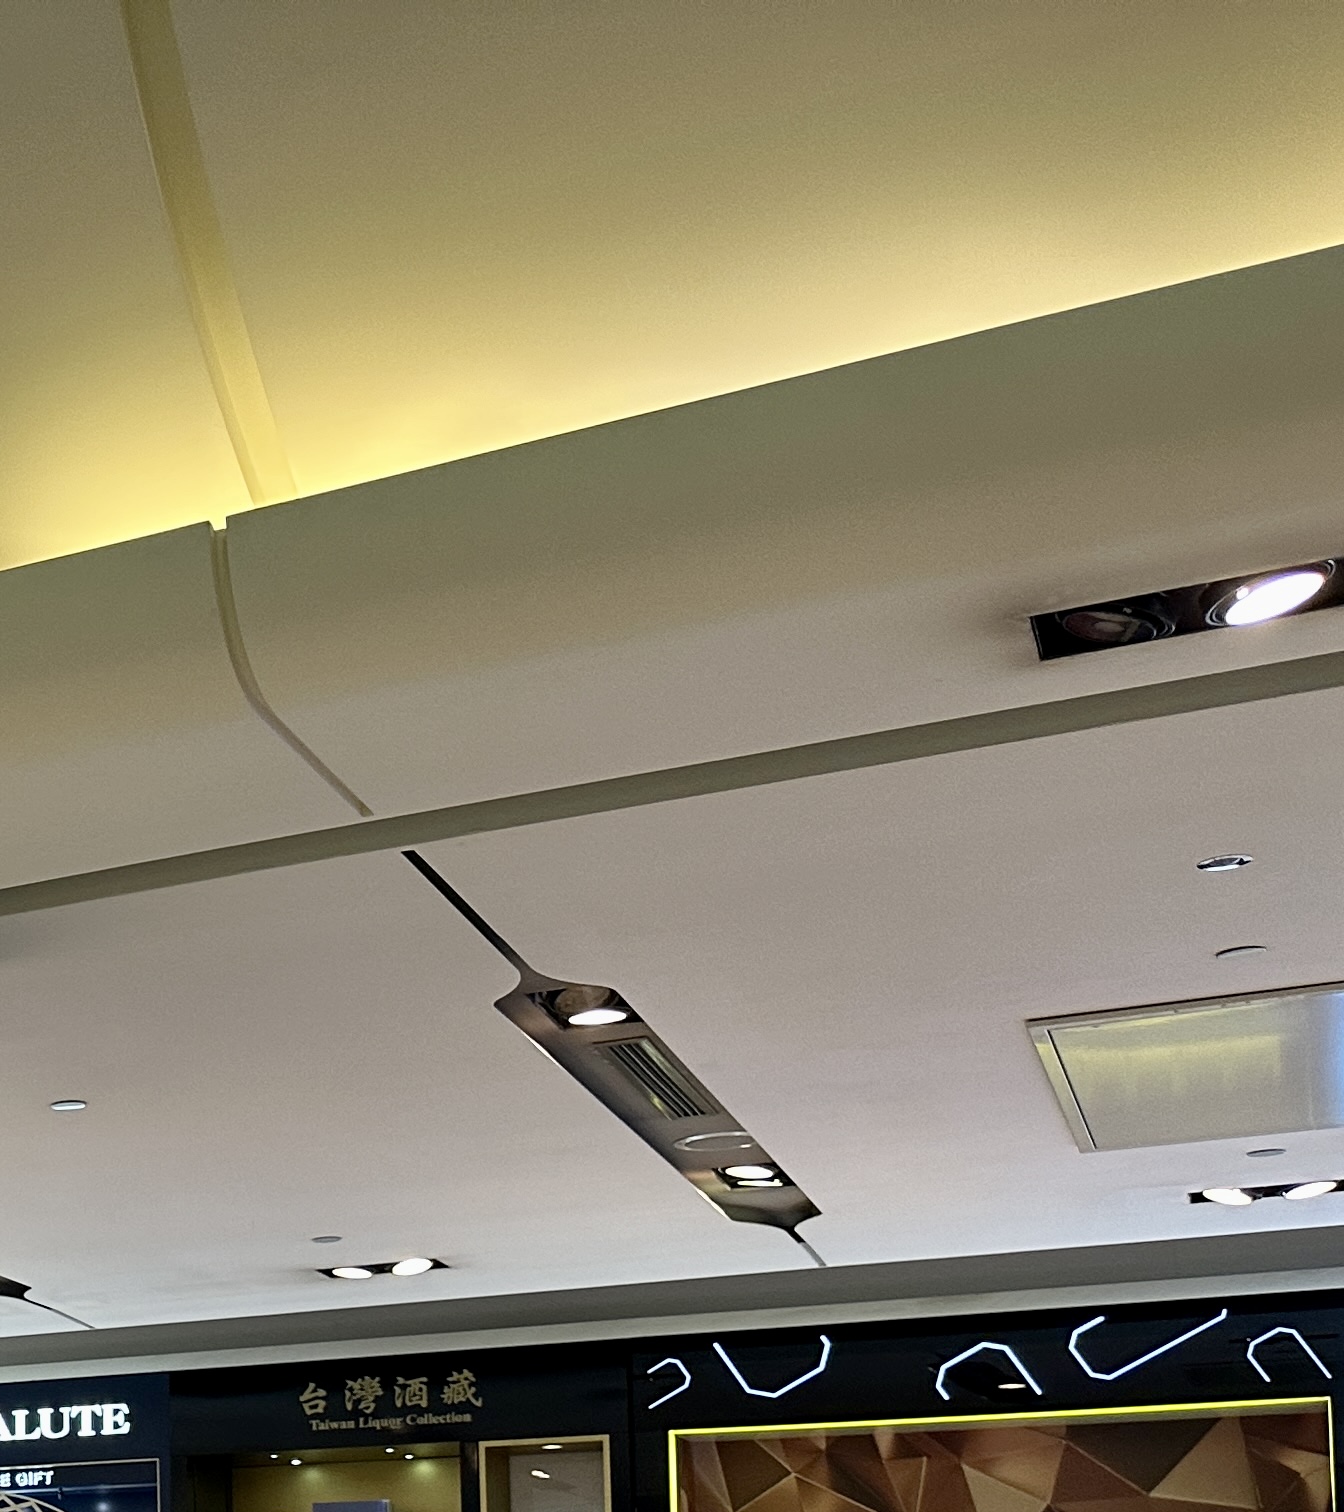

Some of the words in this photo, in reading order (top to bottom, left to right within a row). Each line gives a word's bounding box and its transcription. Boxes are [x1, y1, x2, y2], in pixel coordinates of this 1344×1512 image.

[299, 1369, 483, 1415] 台灣酒藏
[309, 1419, 355, 1431] Taiwan
[359, 1416, 403, 1430] Liquor
[406, 1412, 472, 1426] Collection
[15, 1470, 54, 1487] GIFT
